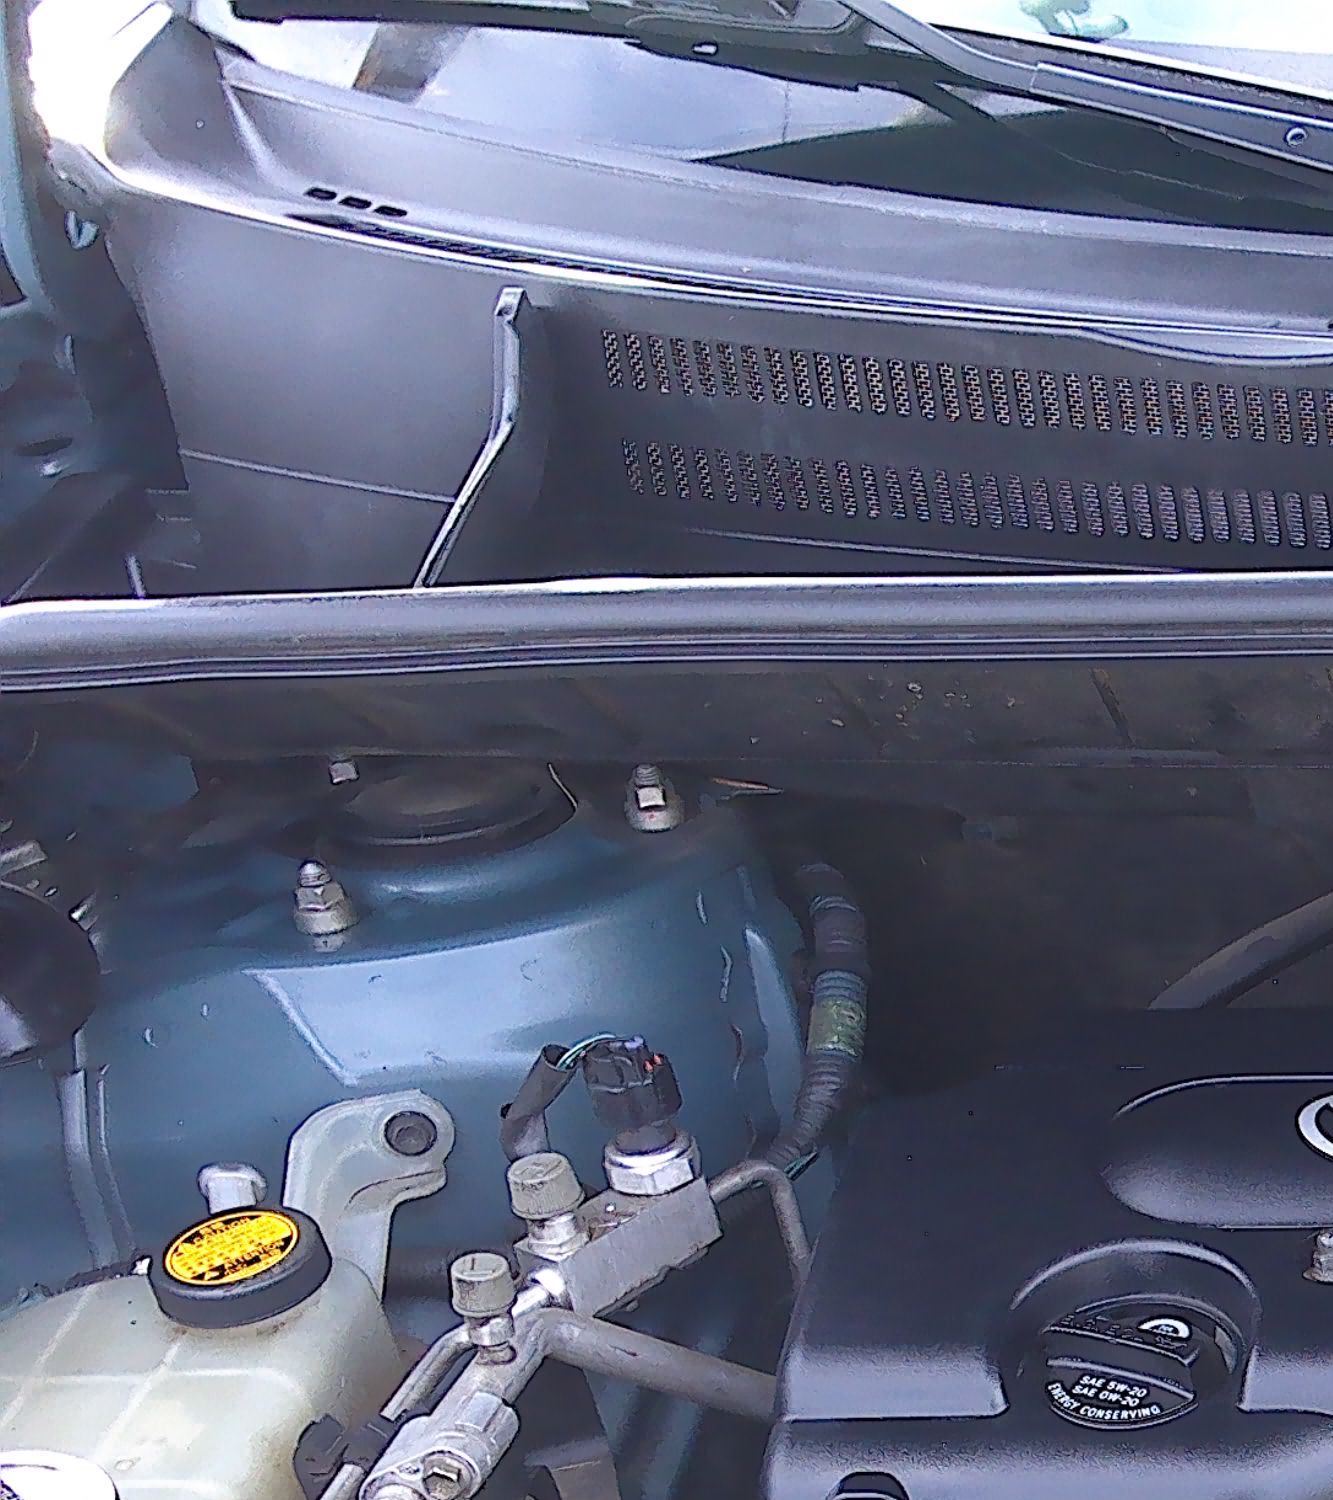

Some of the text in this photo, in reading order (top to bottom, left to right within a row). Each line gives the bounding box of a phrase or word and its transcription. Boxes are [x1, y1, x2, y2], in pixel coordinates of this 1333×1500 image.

[1071, 1385, 1096, 1399] SAE
[1079, 1375, 1148, 1399] SAE 5W-20
[1048, 1382, 1162, 1421] ENERGY CONSERVING
